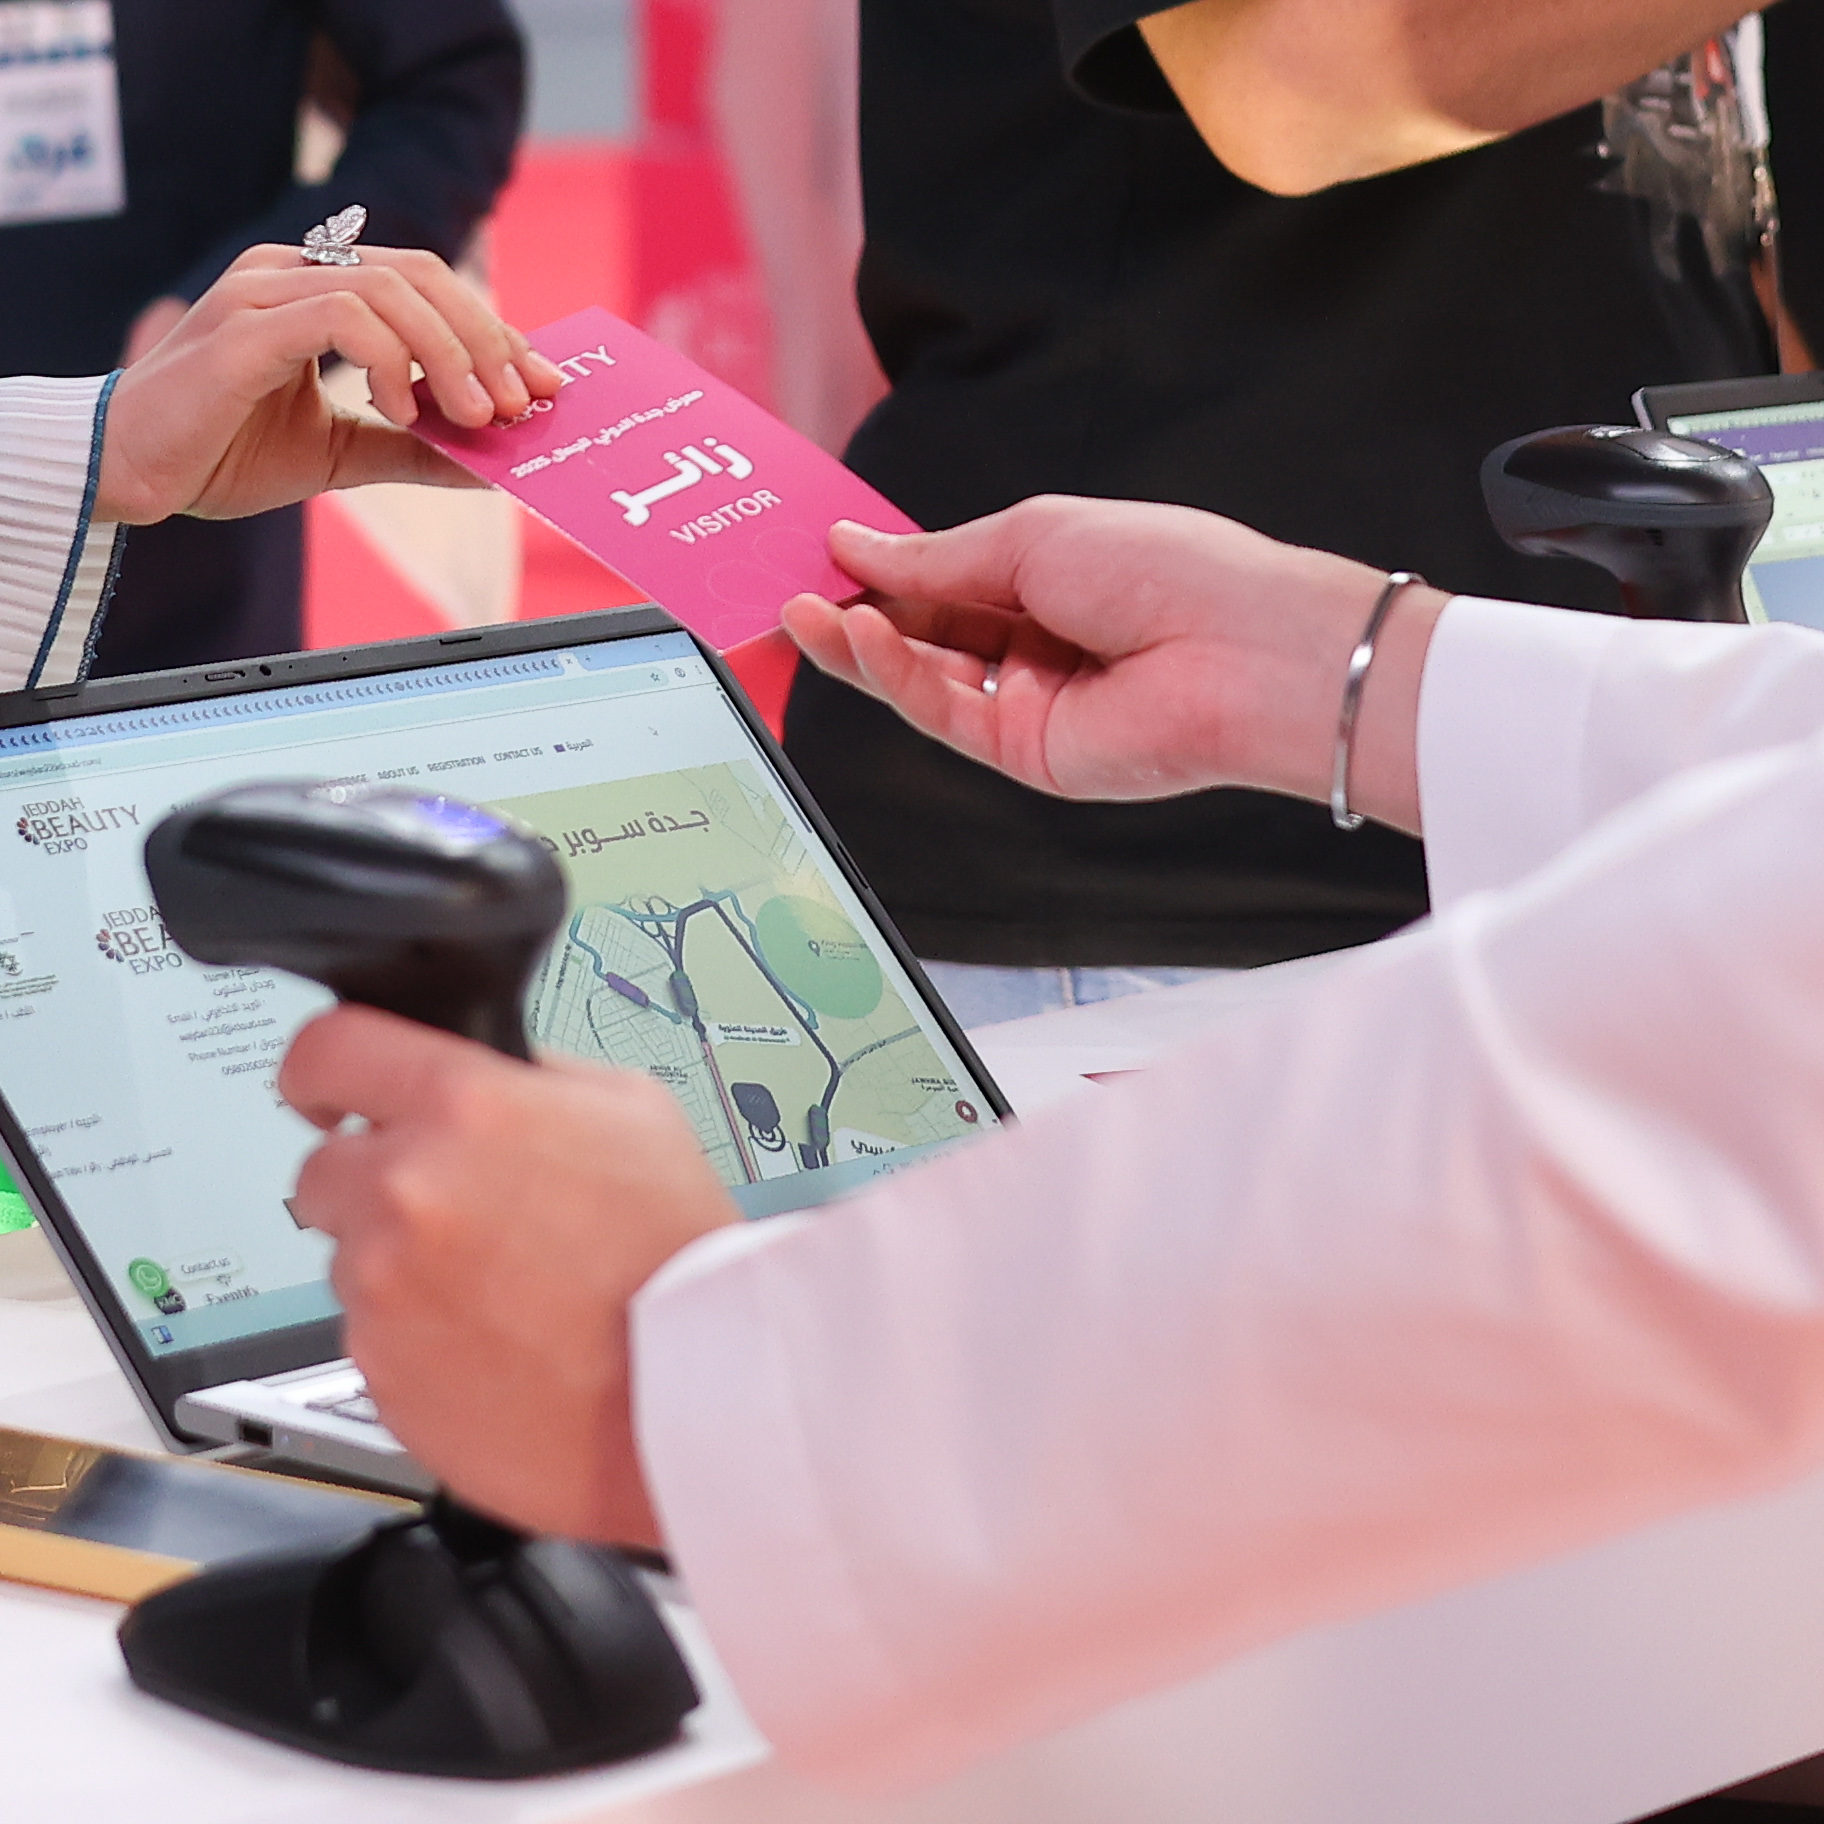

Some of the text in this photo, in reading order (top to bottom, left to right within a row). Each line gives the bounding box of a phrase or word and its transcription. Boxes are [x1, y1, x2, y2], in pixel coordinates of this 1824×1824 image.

[509, 454, 552, 479] 2025
[609, 437, 754, 526] زائر
[669, 489, 782, 544] VISITOR
[427, 756, 486, 772] REGISTRATION
[493, 748, 530, 762] CONTACT
[530, 746, 543, 756] US
[21, 796, 85, 818] JEDDAH
[30, 804, 141, 840] BEAUTY
[645, 809, 710, 833] جدة
[43, 837, 88, 855] EXPO
[563, 819, 646, 857] سوبر
[102, 905, 164, 930] JEDDA
[129, 952, 183, 975] EXPO
